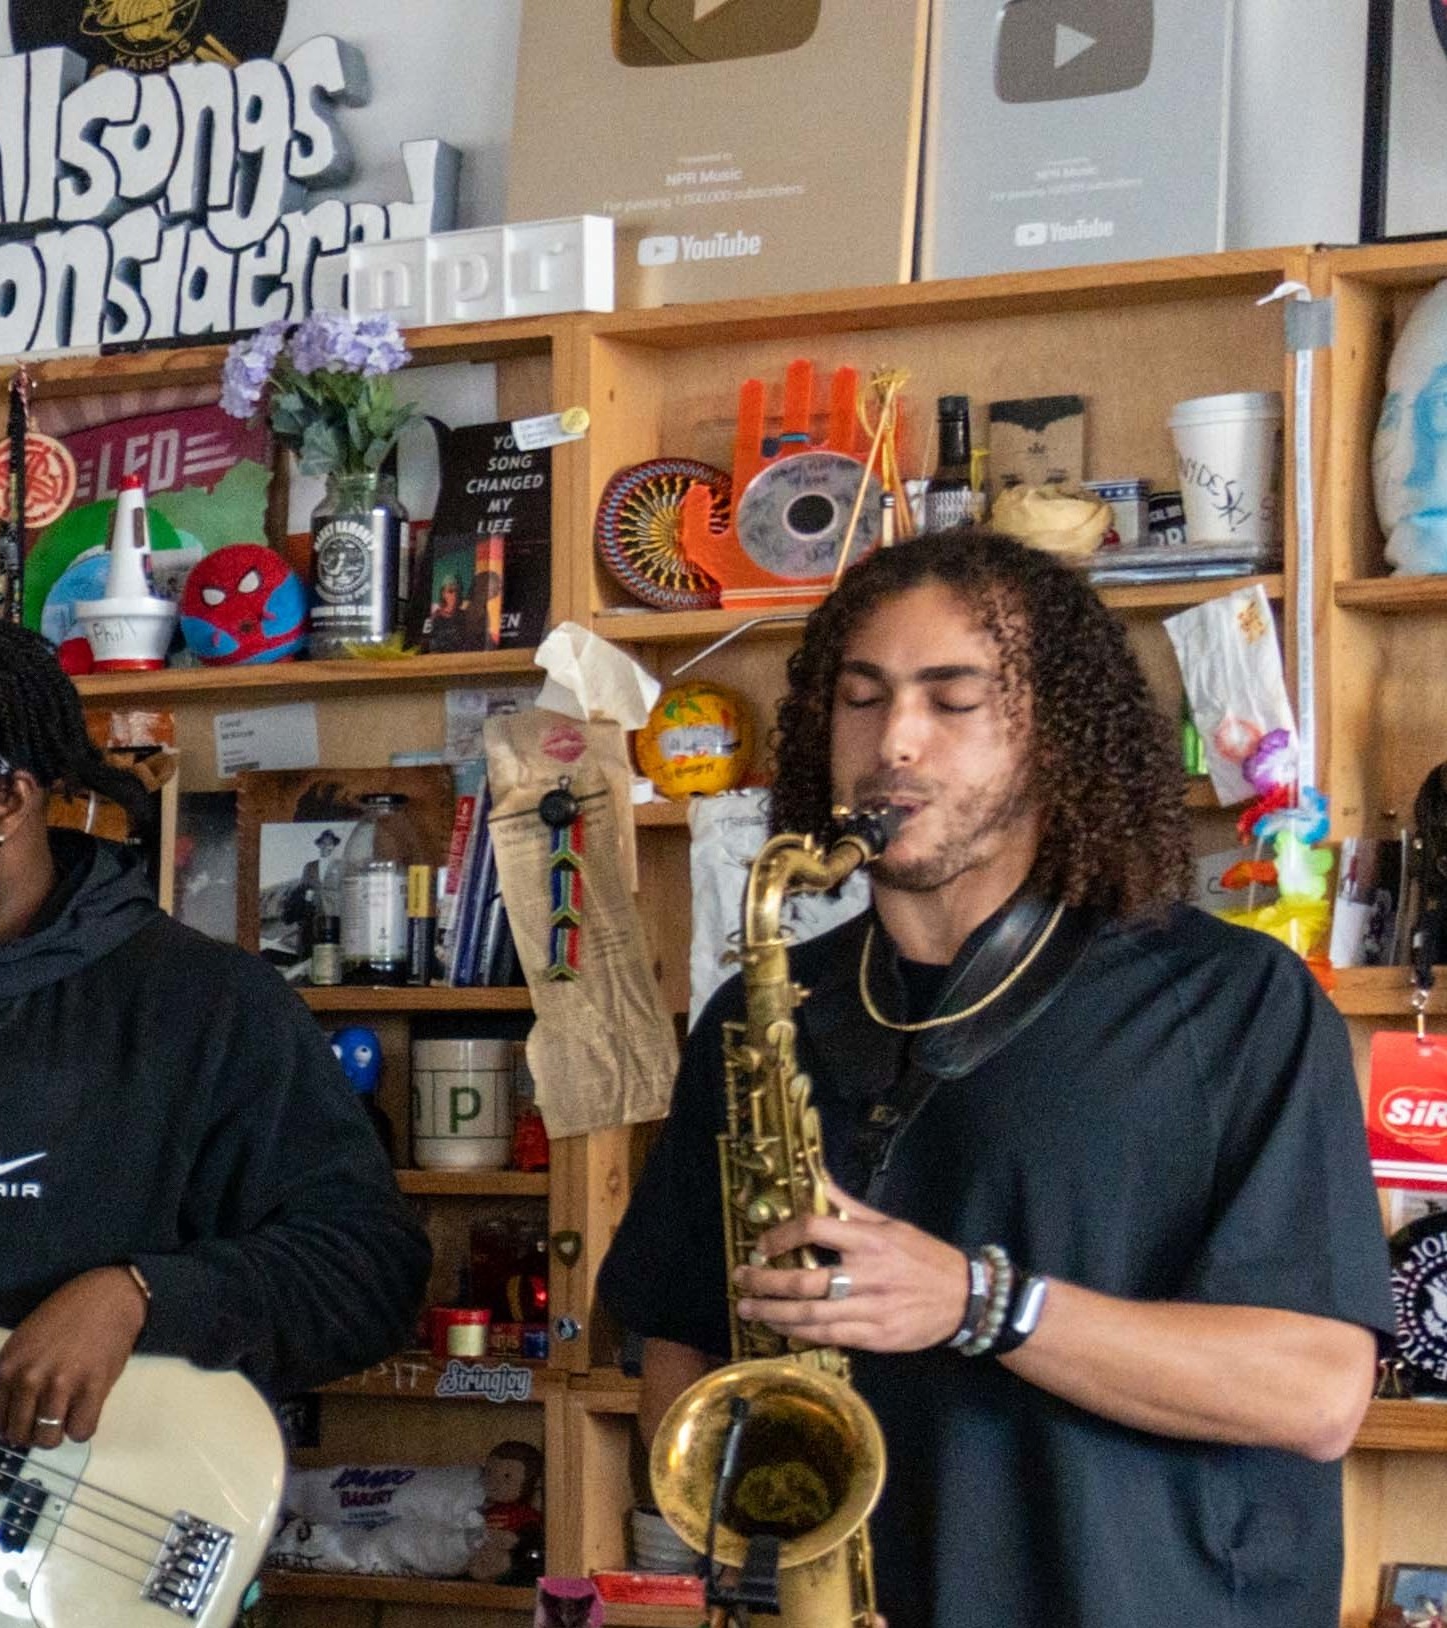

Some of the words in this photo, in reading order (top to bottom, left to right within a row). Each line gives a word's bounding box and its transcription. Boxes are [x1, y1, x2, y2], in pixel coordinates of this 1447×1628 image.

[114, 40, 192, 70] KANSAS
[1050, 217, 1114, 241] YouTube
[681, 231, 761, 261] YouTube
[487, 454, 533, 471] SONG
[466, 474, 545, 492] CHANGED
[487, 497, 513, 513] MY
[477, 516, 514, 535] LIFE
[436, 1361, 533, 1402] Stringjoy
